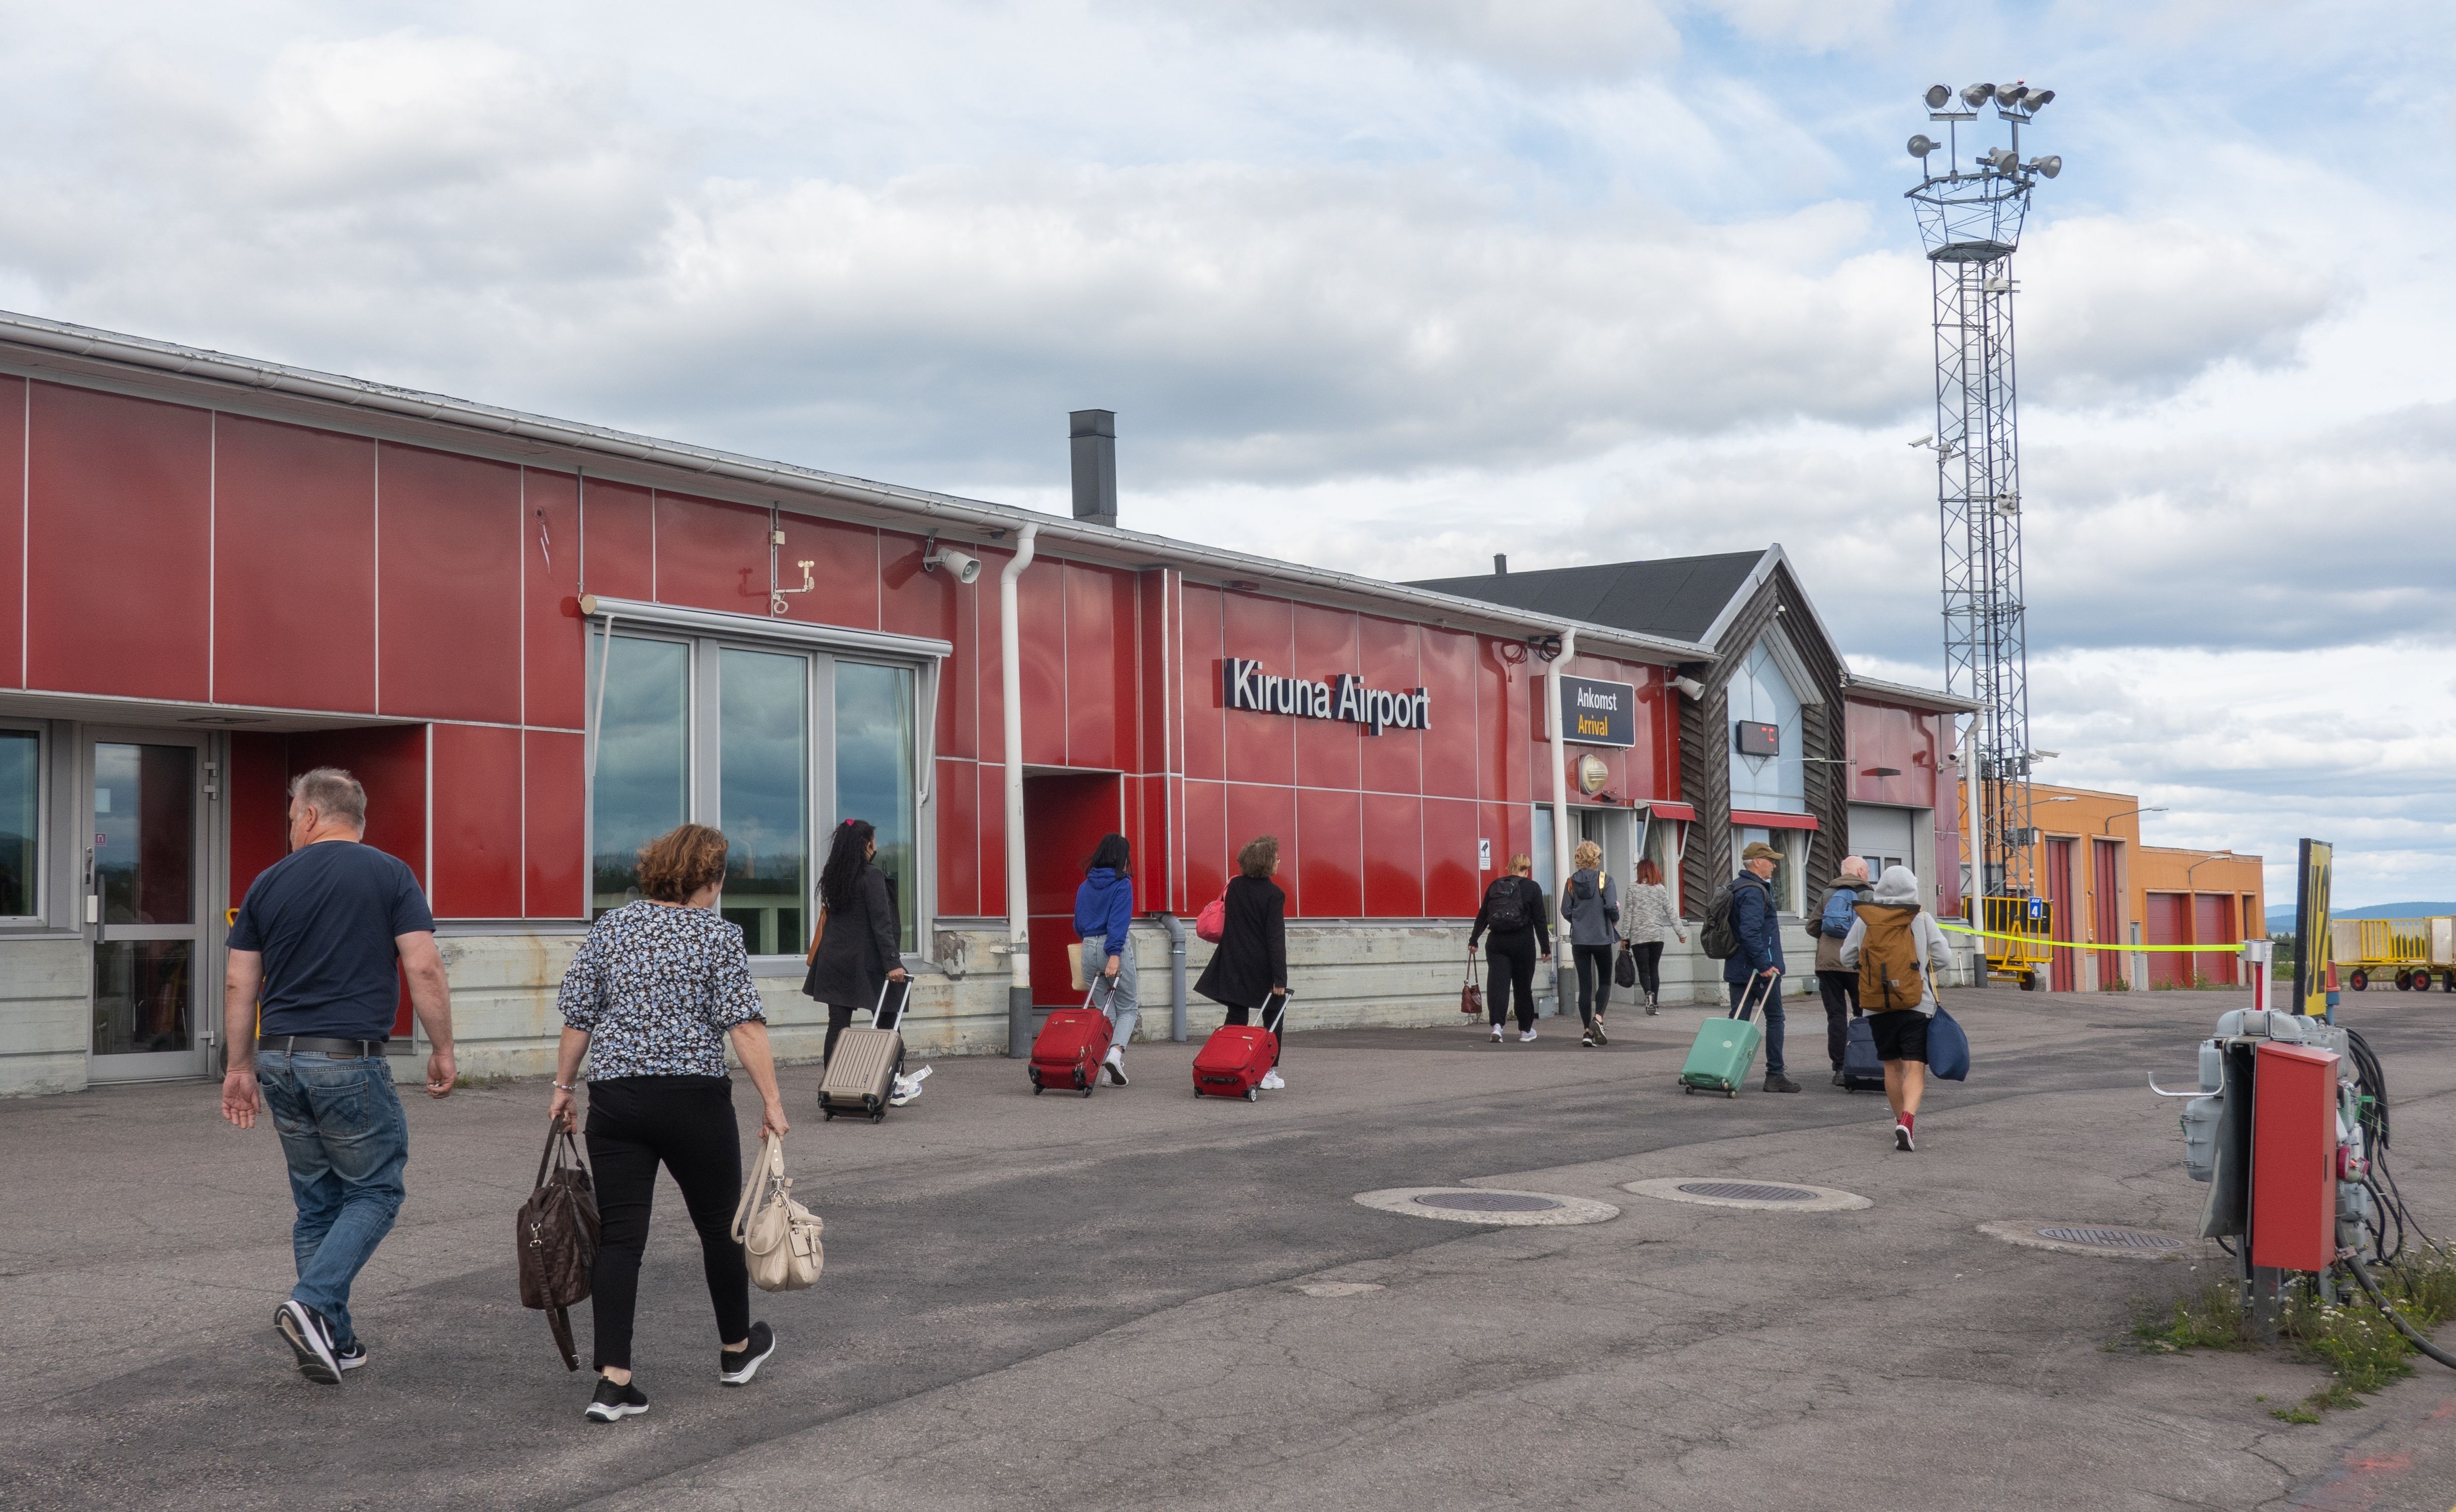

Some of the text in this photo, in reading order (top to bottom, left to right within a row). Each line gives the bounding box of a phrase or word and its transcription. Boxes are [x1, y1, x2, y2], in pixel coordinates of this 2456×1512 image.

[1233, 657, 1431, 736] Kiruna Airport
[1577, 687, 1617, 711] Ankomst
[1578, 714, 1608, 737] Arrival
[2032, 906, 2038, 917] 4
